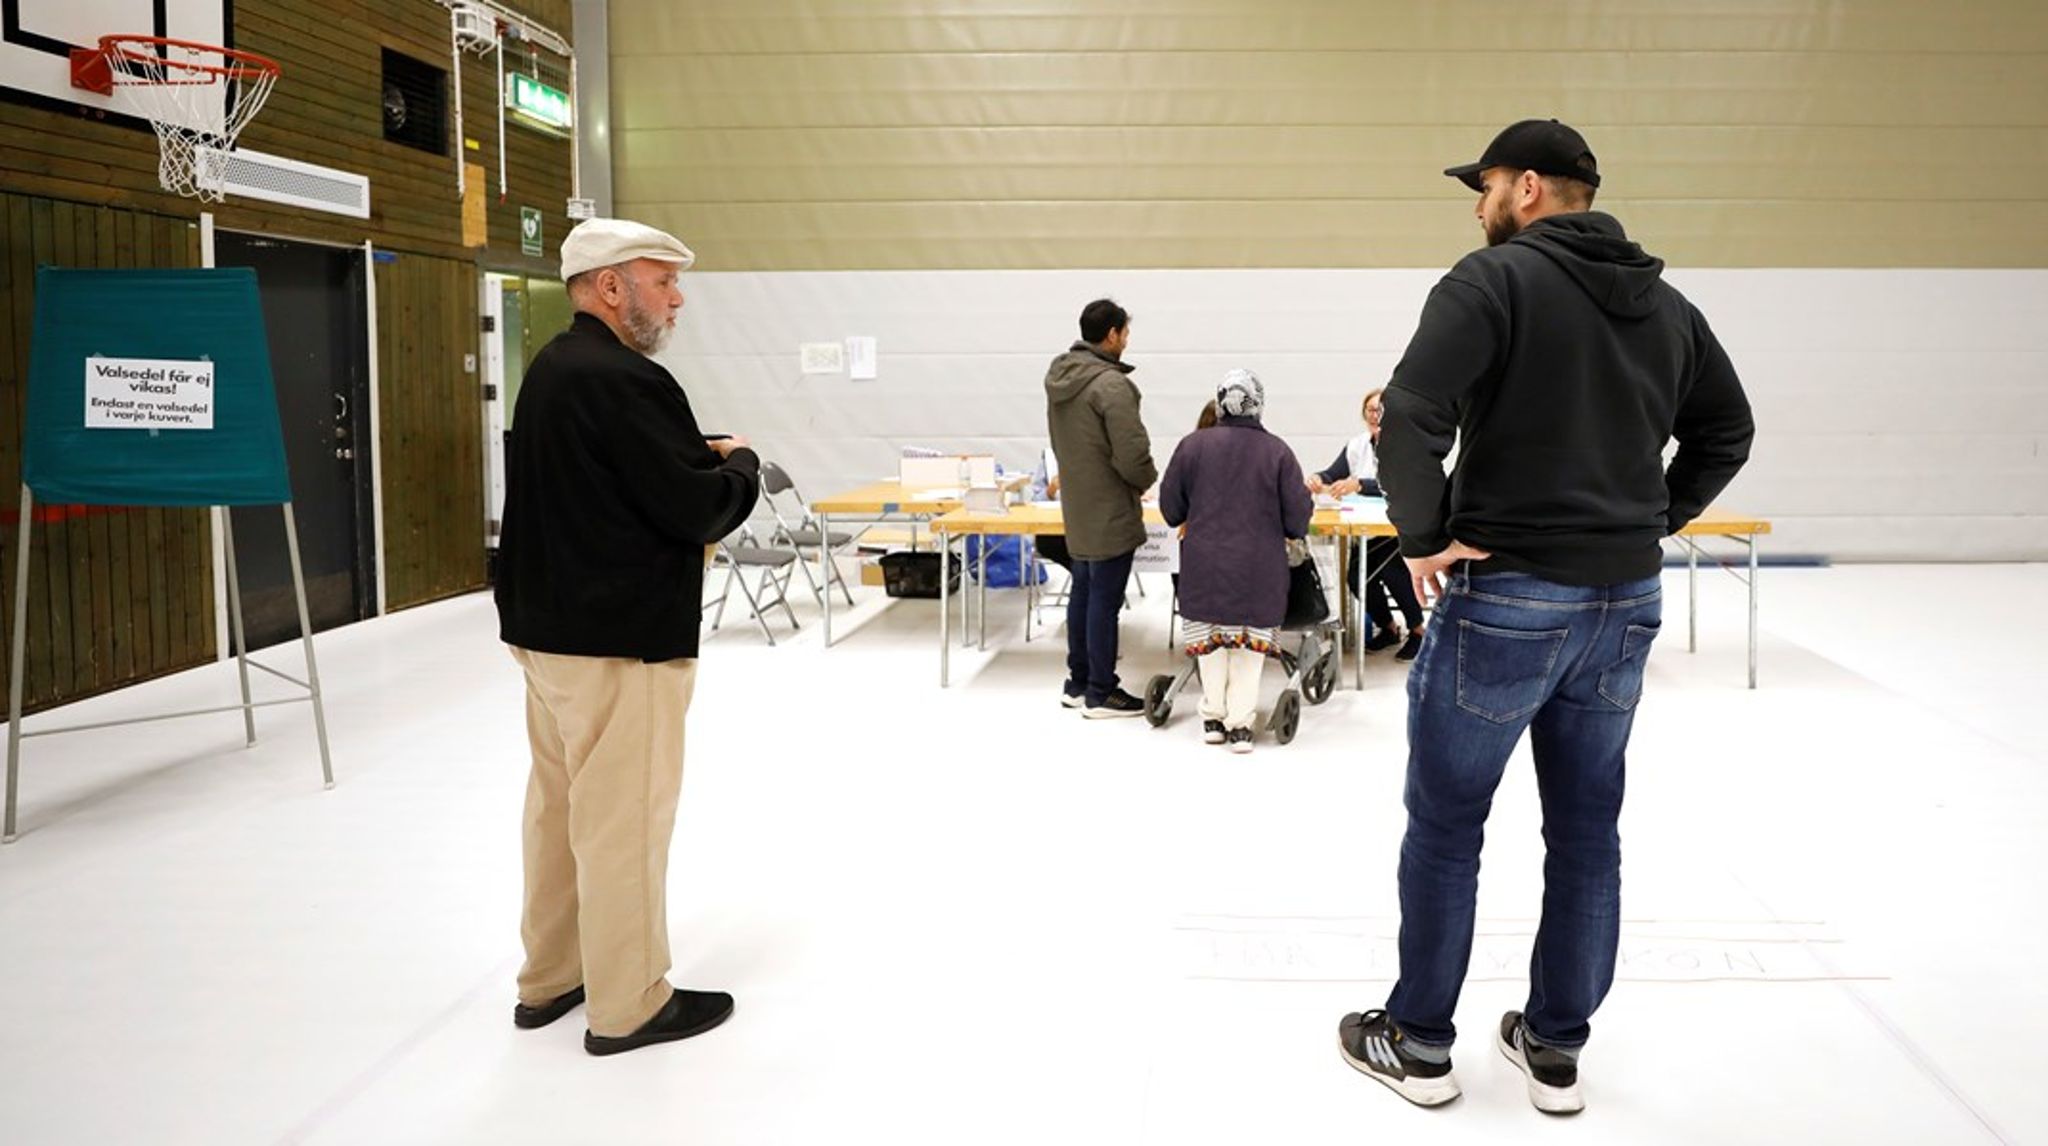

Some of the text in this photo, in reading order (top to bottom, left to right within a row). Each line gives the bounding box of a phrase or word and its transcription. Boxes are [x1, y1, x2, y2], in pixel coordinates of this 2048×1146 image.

[95, 364, 210, 388] Valsedel får ej
[129, 380, 177, 395] vikas!
[91, 397, 208, 414] Endast en valsedel
[112, 410, 146, 422] varje
